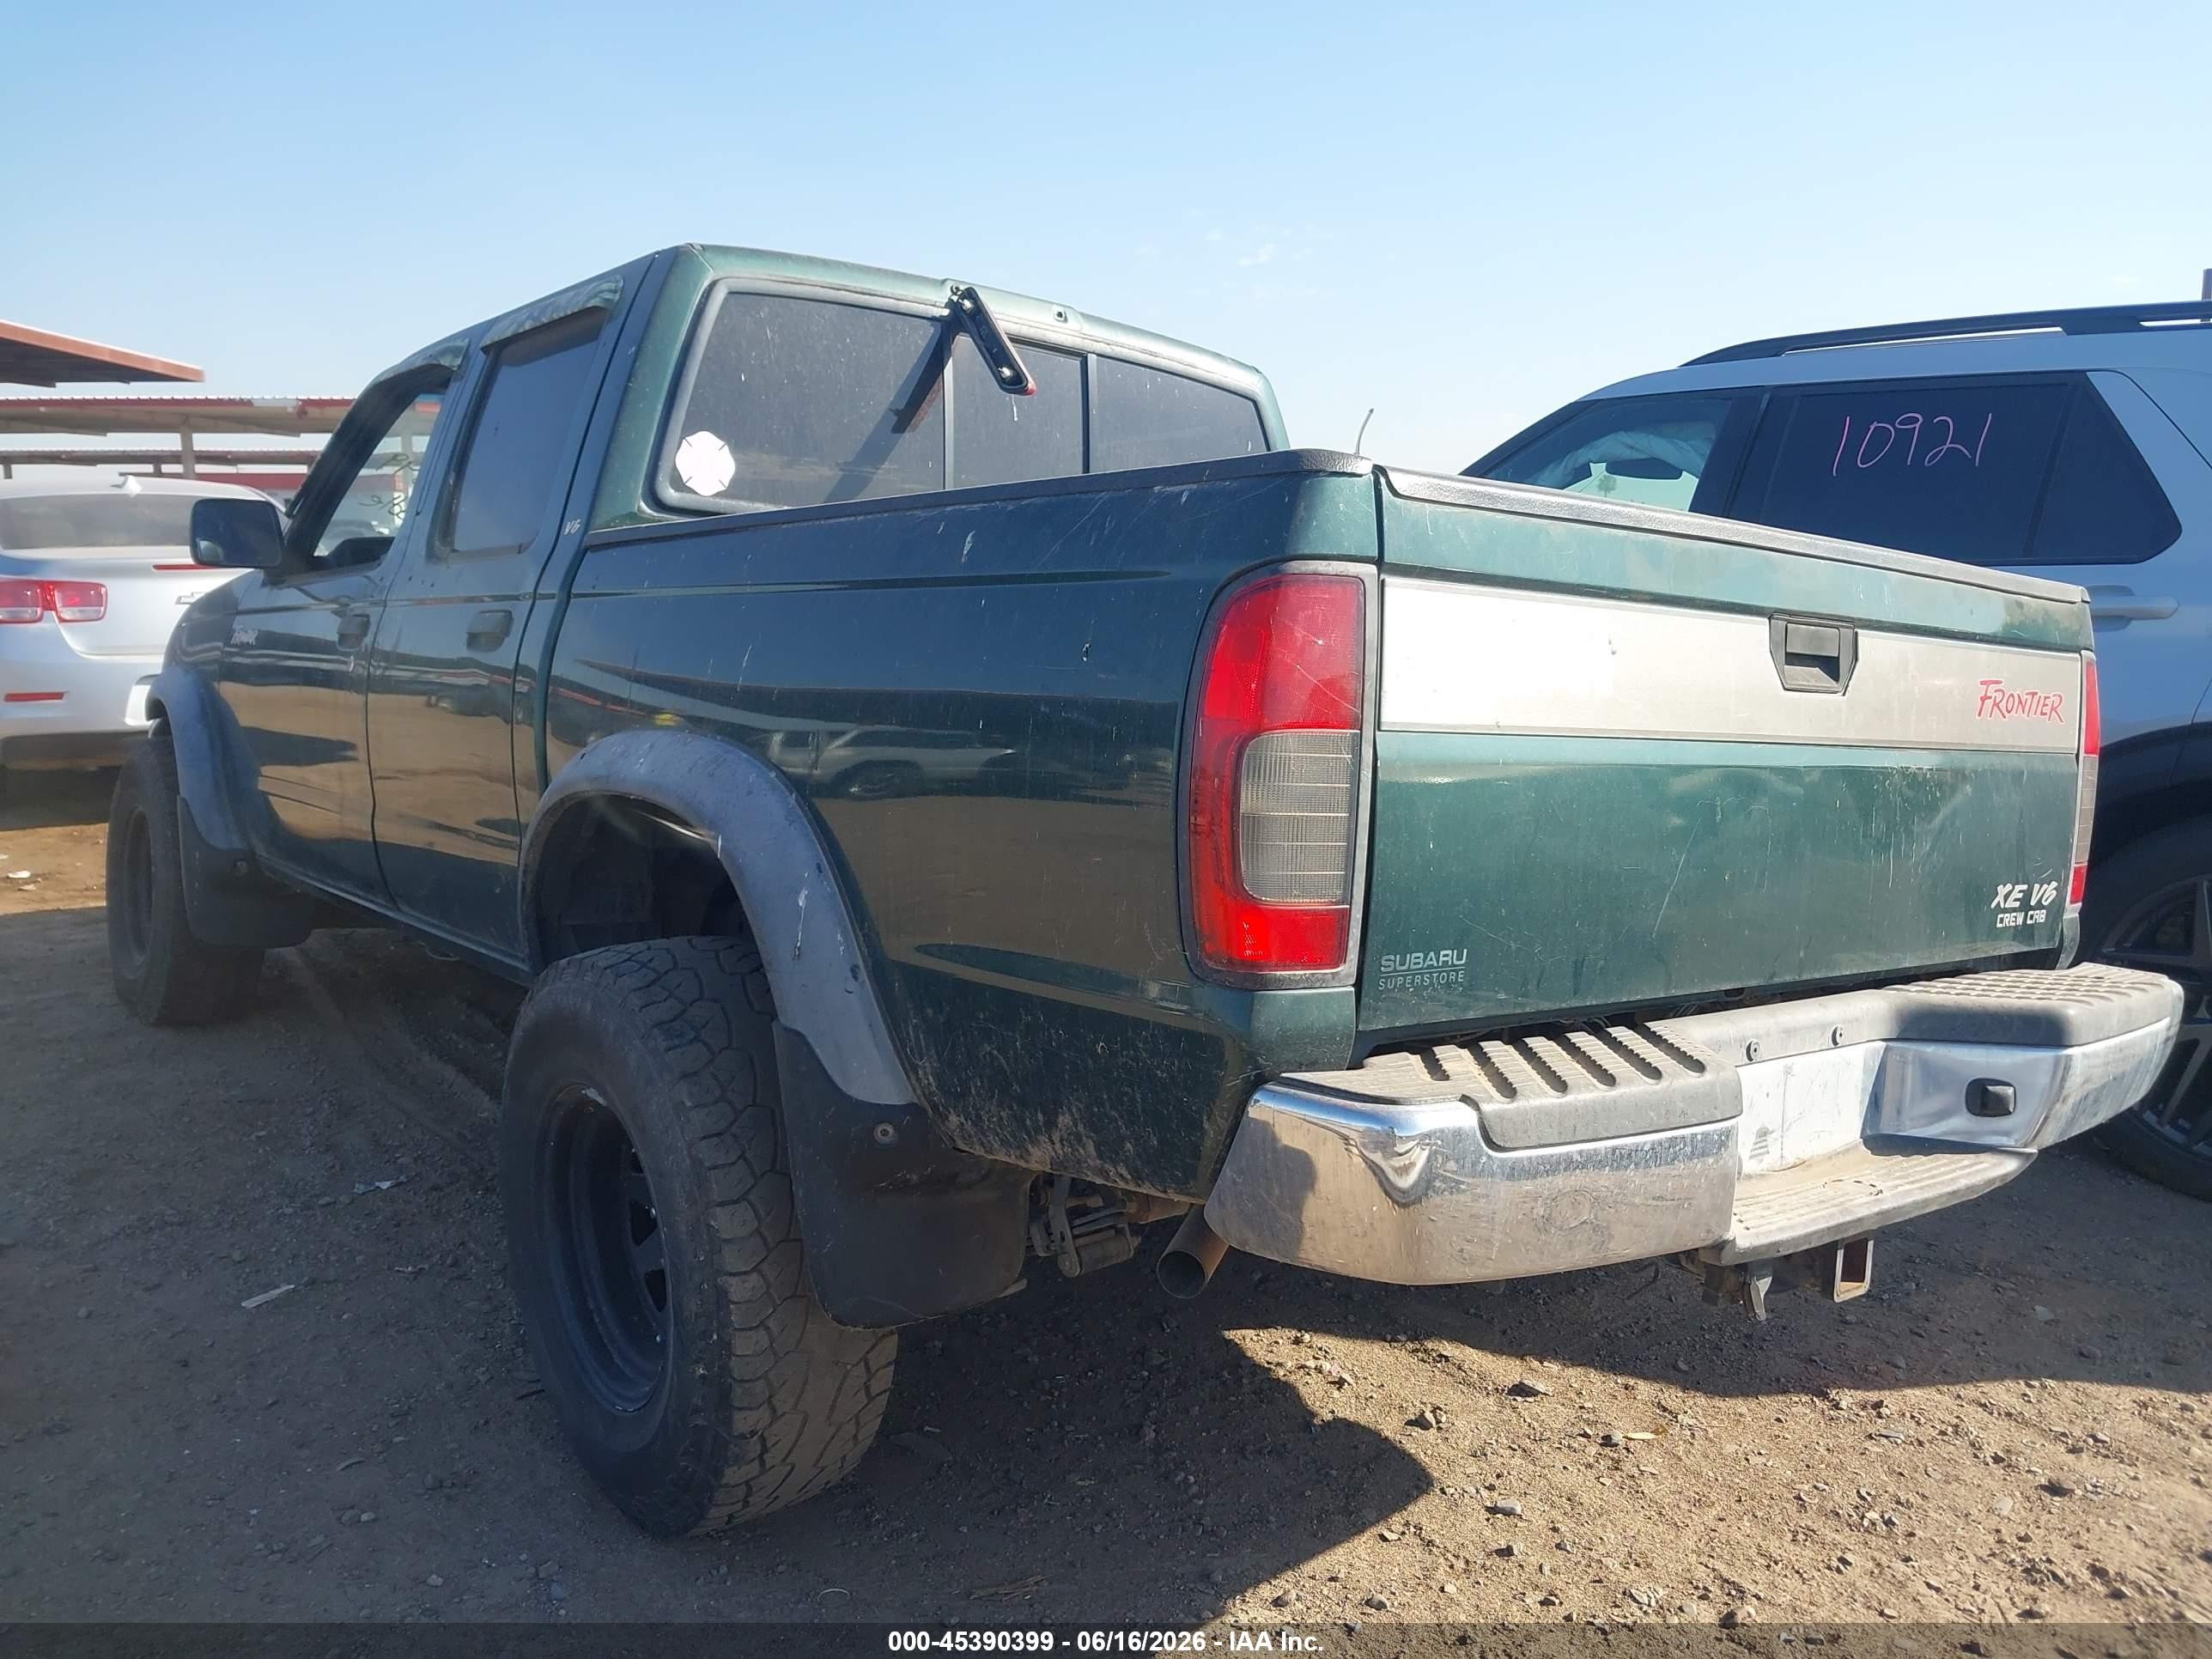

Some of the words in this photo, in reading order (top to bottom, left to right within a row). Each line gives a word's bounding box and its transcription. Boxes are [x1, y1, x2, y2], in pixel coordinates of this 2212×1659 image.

[1832, 412, 1992, 477] 10921
[1977, 678, 2065, 724] FRONTIER
[1990, 883, 2028, 908] XE
[2030, 880, 2058, 906] V6
[1996, 912, 2025, 928] CREW
[2026, 909, 2047, 925] CAB
[1380, 948, 1468, 972] SUBARU
[1377, 970, 1465, 990] SUPERSTORE
